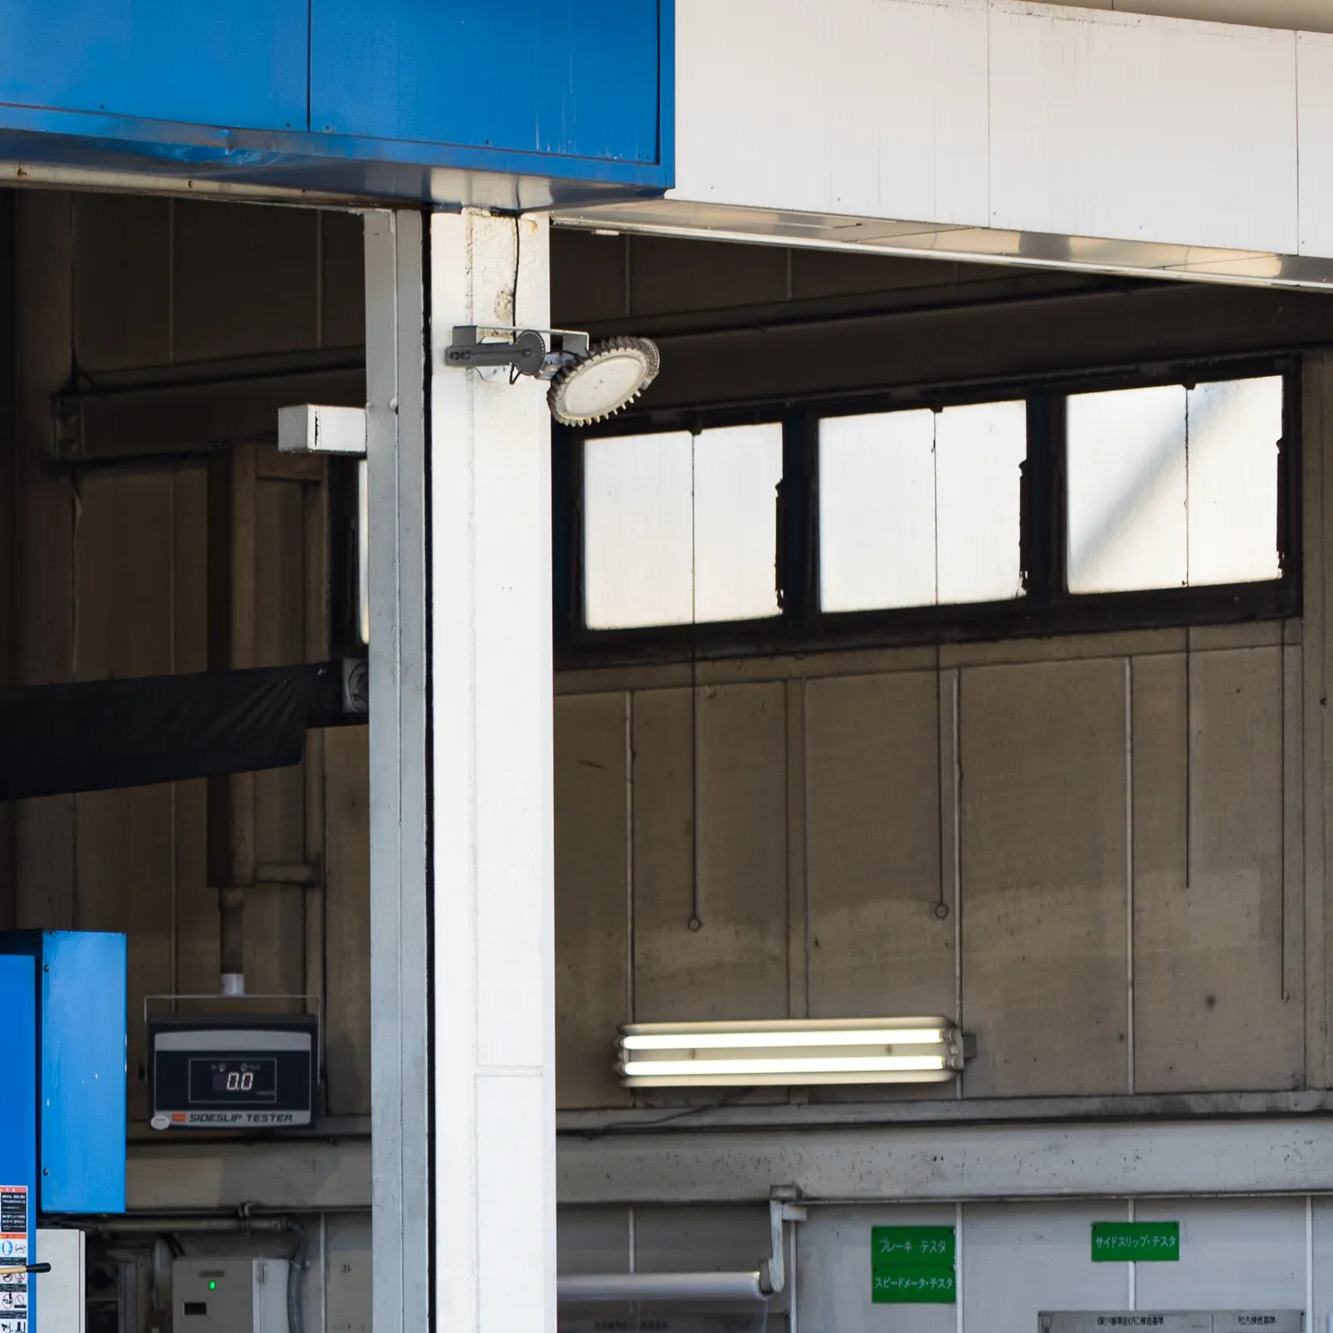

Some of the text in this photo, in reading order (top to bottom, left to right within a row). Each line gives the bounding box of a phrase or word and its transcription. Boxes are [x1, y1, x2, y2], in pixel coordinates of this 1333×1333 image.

[226, 1072, 254, 1091] 0.0
[189, 1113, 293, 1123] SIDESLIP TESTER
